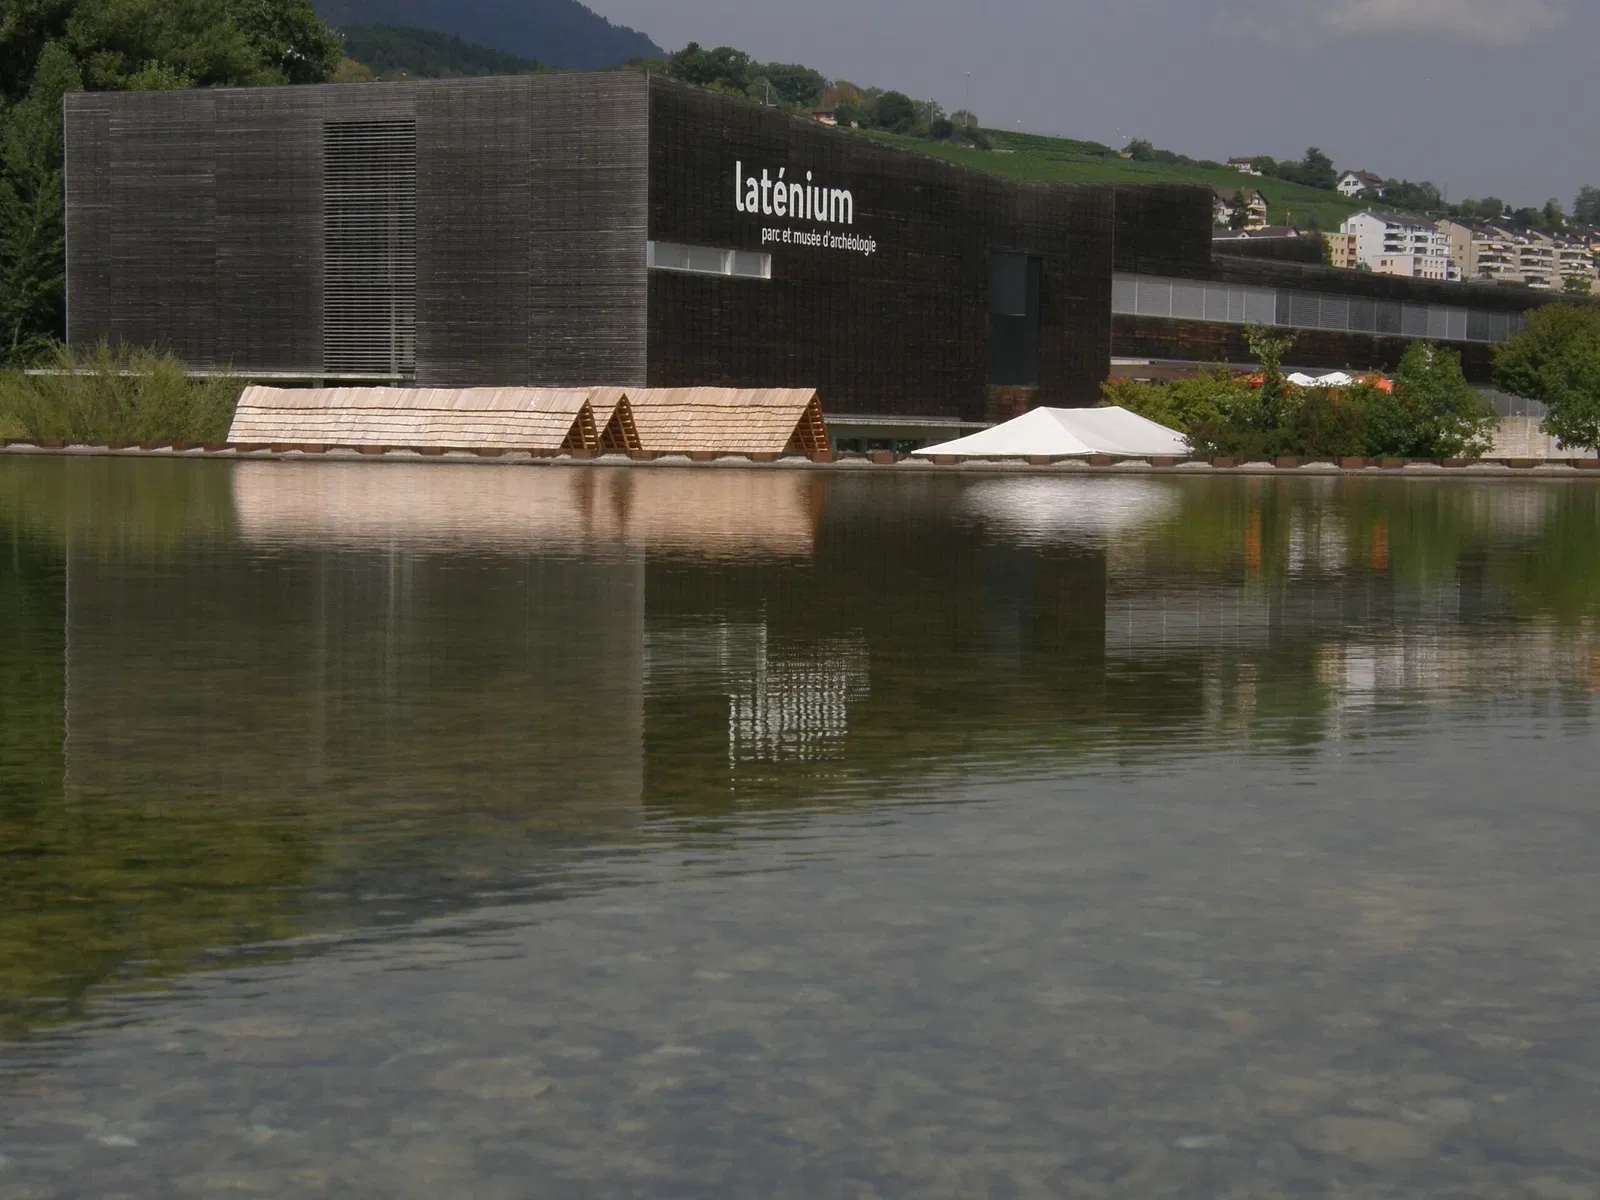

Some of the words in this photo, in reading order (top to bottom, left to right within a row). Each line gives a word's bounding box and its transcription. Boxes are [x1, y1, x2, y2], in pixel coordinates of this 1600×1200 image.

[735, 160, 853, 224] laténium
[761, 228, 780, 244] parc
[782, 227, 791, 243] et
[793, 229, 821, 246] musée
[823, 230, 876, 256] d'archéologie
